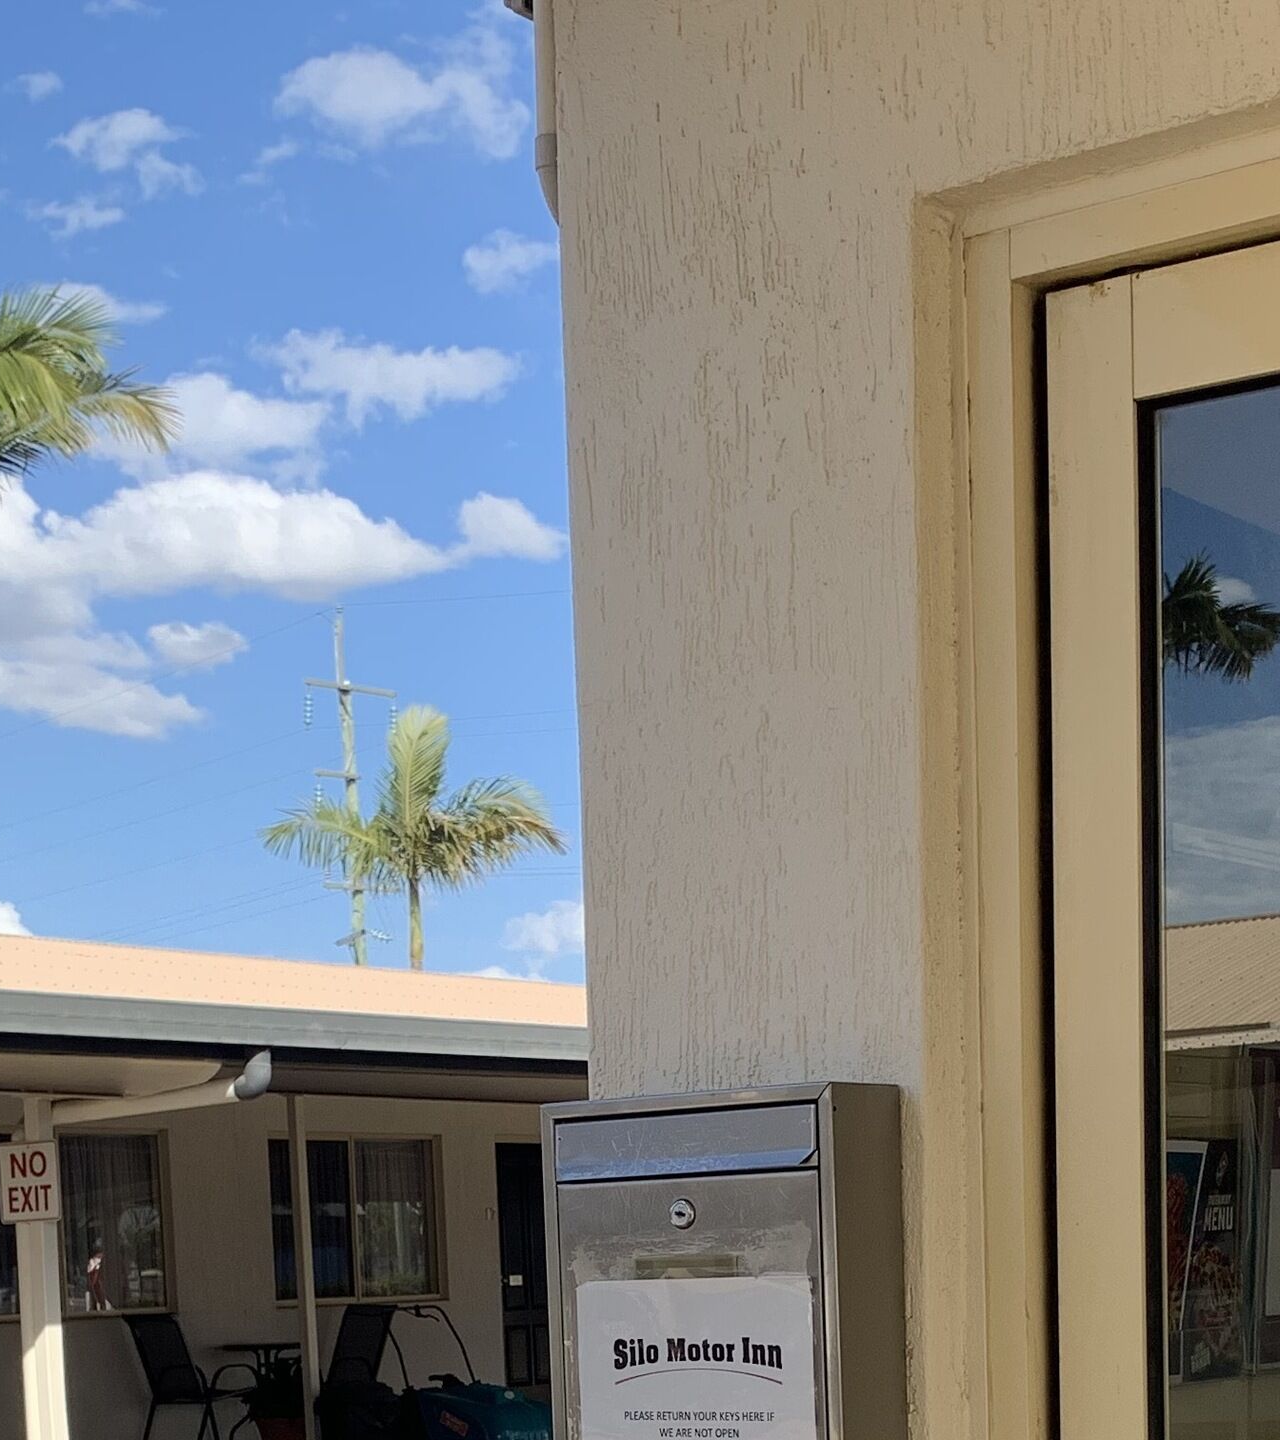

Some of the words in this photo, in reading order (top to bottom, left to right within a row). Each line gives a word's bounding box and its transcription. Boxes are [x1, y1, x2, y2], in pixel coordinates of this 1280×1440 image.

[10, 1151, 47, 1178] NO
[8, 1184, 52, 1213] EXIT
[613, 1337, 659, 1371] Silo
[666, 1337, 736, 1363] Motor
[742, 1336, 783, 1370] Inn
[624, 1410, 655, 1422] PLEASE
[656, 1410, 691, 1422] RETURN
[692, 1410, 718, 1422] YOUR
[719, 1411, 740, 1422] KEYS
[741, 1411, 766, 1422] HERE
[766, 1411, 776, 1422] IF
[658, 1427, 675, 1438] WE
[675, 1427, 693, 1438] ARE
[694, 1427, 714, 1438] NOT
[715, 1427, 740, 1438] OPEN
